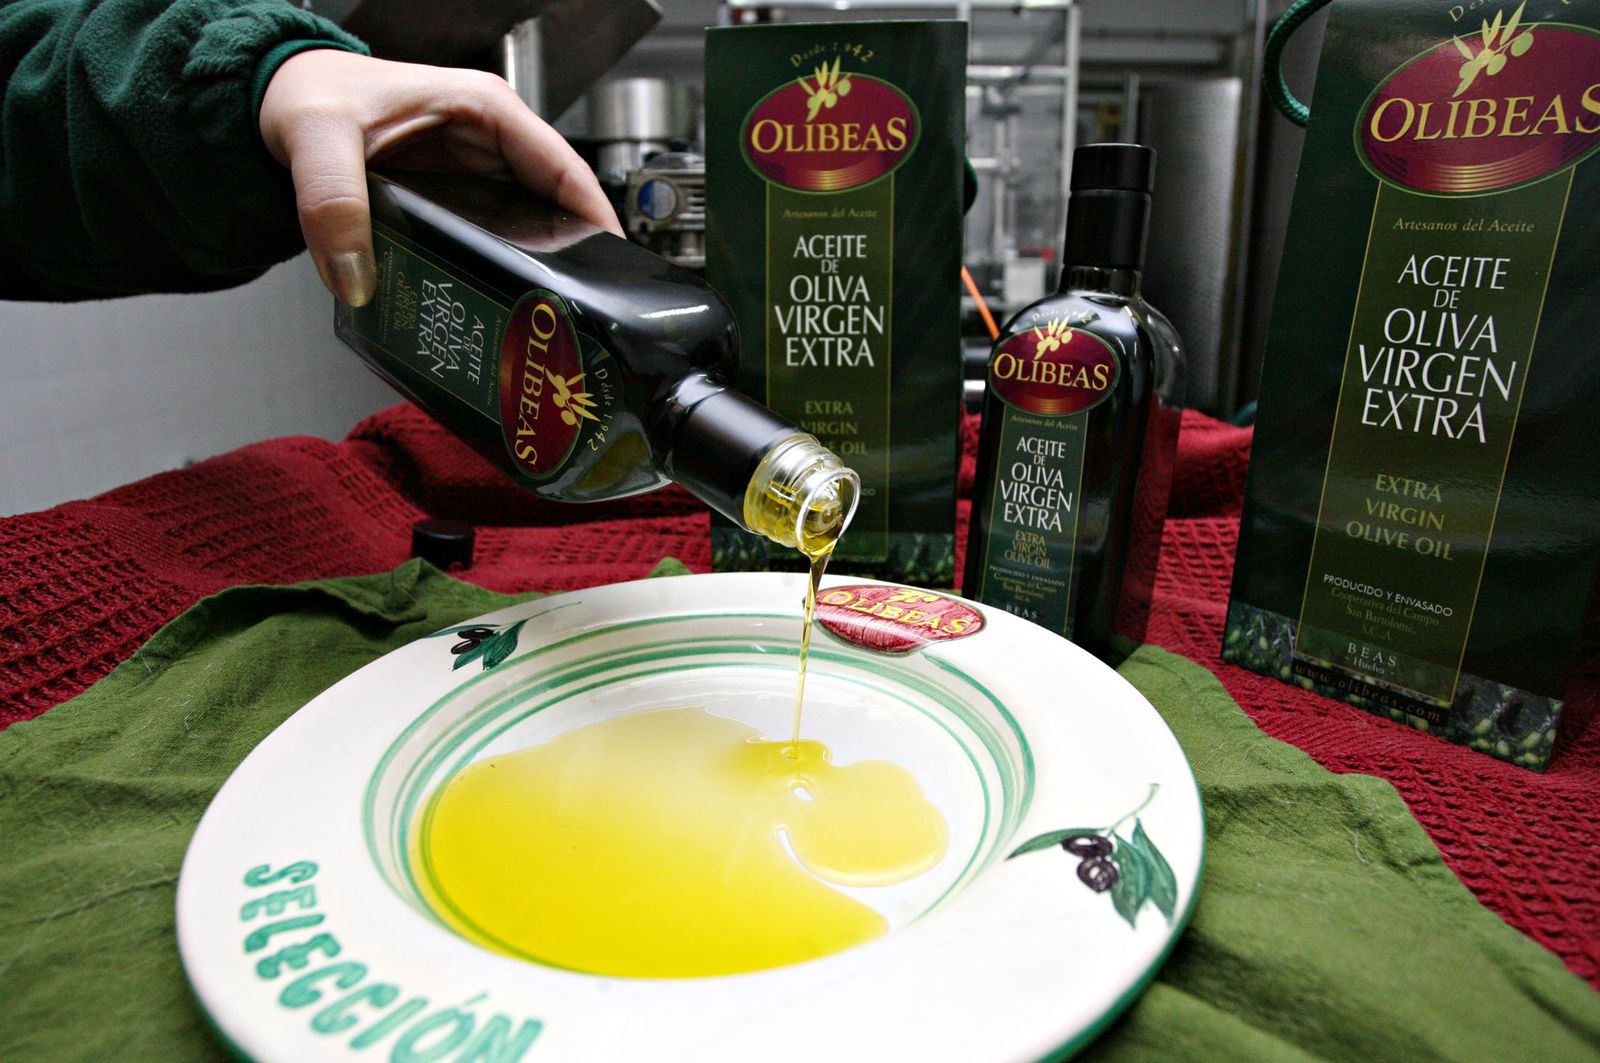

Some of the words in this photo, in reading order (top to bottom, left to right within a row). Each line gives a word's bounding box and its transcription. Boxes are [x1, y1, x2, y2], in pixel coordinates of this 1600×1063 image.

[752, 117, 907, 153] OLIBEAS
[1393, 218, 1458, 231] Artesanos
[1462, 219, 1484, 232] del
[1488, 219, 1535, 233] Aceite
[793, 234, 867, 258] ACEITE
[821, 259, 839, 274] DE
[1397, 254, 1511, 290] ACEITE
[789, 274, 870, 303] OLIVA
[1433, 289, 1461, 309] DE
[416, 279, 437, 356] EXTRA
[429, 283, 453, 378] VIRGEN
[775, 304, 884, 335] VIRGEN
[1384, 307, 1498, 353] OLIVA
[446, 301, 466, 371] OLIVA
[467, 314, 485, 384] ACEITE
[786, 337, 875, 367] EXTRA
[514, 303, 557, 465] OLIBEAS
[994, 353, 1109, 391] OLIBEAS
[1359, 344, 1517, 401] VIRGEN
[805, 400, 854, 415] EXTRA
[1361, 387, 1486, 444] EXTRA
[841, 441, 868, 455] OIL
[1016, 436, 1067, 459] ACEITE
[1033, 454, 1046, 466] DE
[1011, 462, 1064, 489] OLIVA
[1374, 473, 1442, 503] EXTRA
[1000, 479, 1073, 513] VIRGEN
[1004, 502, 1062, 533] EXTRA
[1365, 498, 1445, 531] VIRGIN
[1012, 540, 1047, 557] VIRGIN
[1015, 530, 1046, 546] EXTRA
[1346, 520, 1409, 549] OLIVE
[1414, 536, 1454, 561] OIL
[1004, 549, 1032, 565] OLIVE
[1034, 556, 1051, 570] OIL
[1323, 573, 1383, 598] PRODUCIDO
[1386, 591, 1393, 600] Y
[1394, 594, 1453, 617] ENVASADO
[822, 591, 971, 634] OLIBEAS
[1347, 642, 1398, 667] BEAS
[240, 860, 544, 1063] SELECCIÓN
